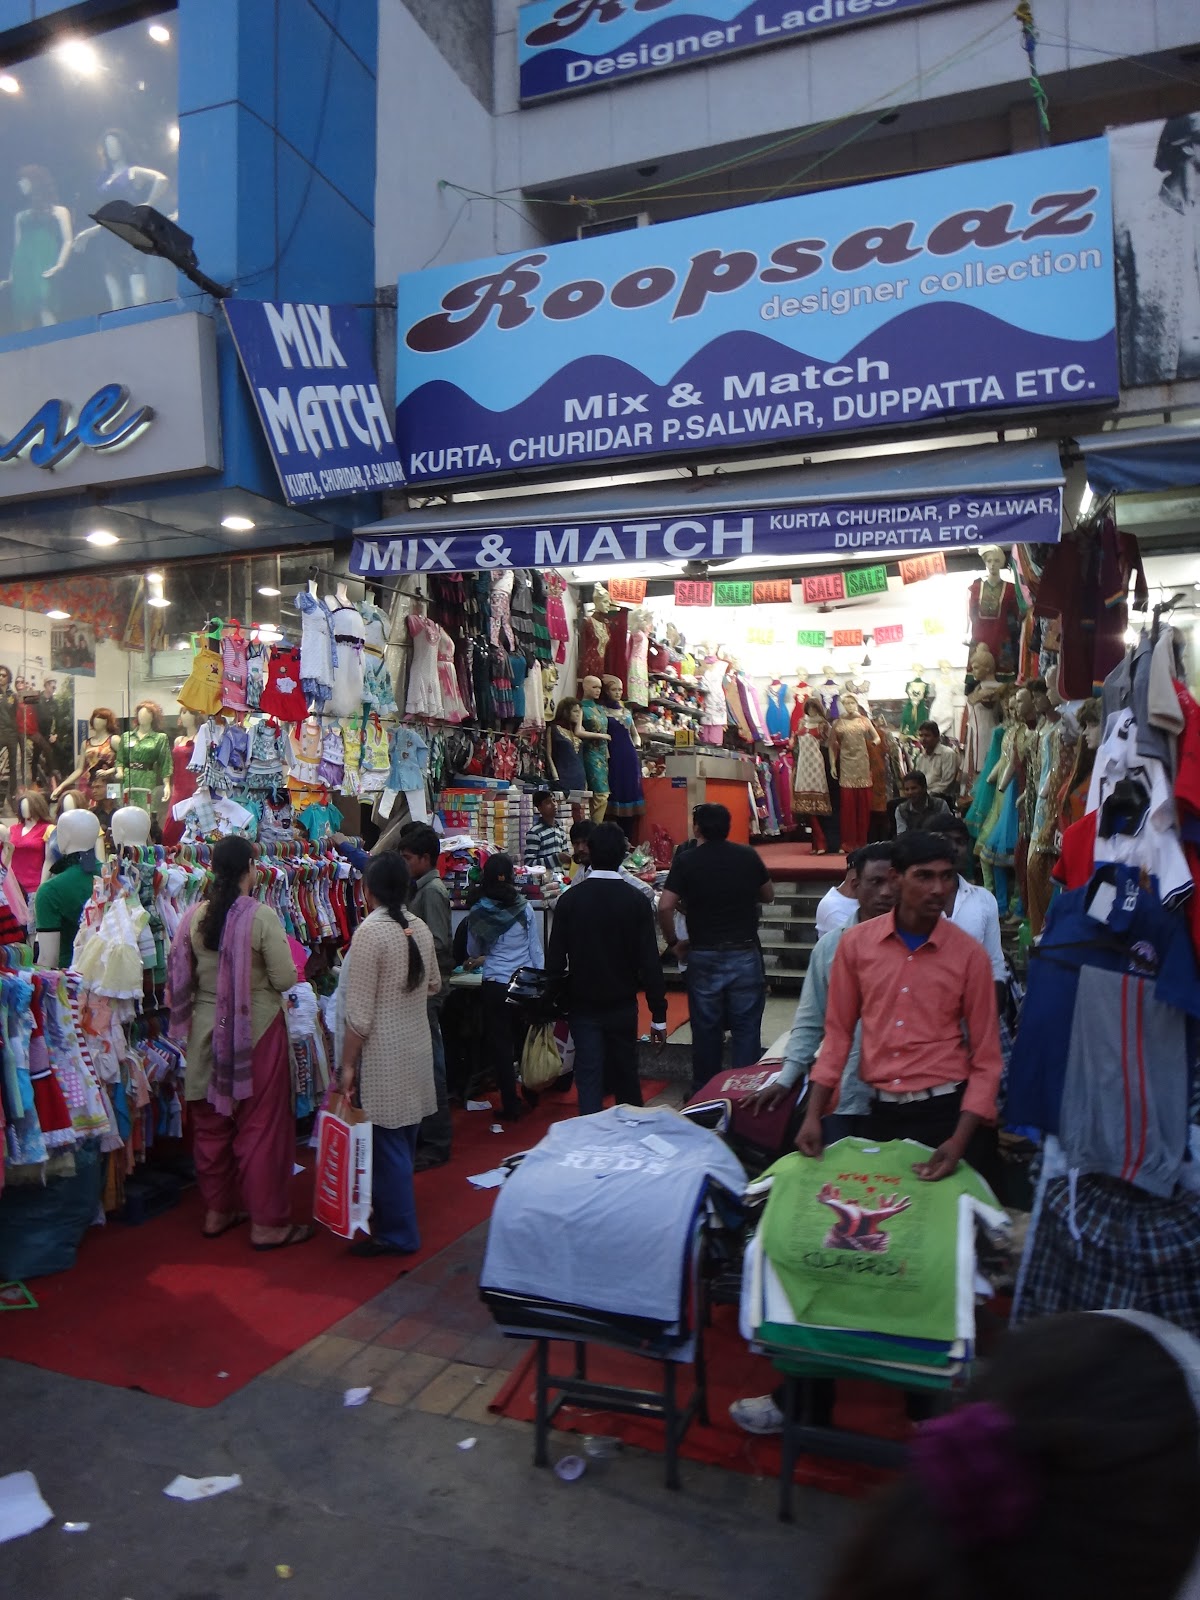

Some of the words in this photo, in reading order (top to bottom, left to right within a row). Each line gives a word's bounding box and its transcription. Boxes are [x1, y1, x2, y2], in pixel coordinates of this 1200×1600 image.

[566, 25, 742, 84] Designer
[405, 187, 1099, 353] Roopsaaz
[760, 277, 910, 321] designer
[919, 247, 1102, 297] collection
[262, 302, 348, 369] MIX
[564, 392, 649, 423] Mix
[667, 382, 704, 408] &
[723, 357, 890, 401] Match
[258, 384, 396, 460] MATCH
[410, 442, 502, 475] KURTA,
[508, 422, 653, 462] CHURIDAR
[662, 399, 824, 443] P.SALWAR,
[833, 375, 1004, 422] DUPPATTA
[1015, 364, 1096, 398] ETC.
[285, 472, 322, 497] KURTA,
[770, 511, 831, 530] KURTA
[836, 505, 943, 527] CHURIDAR,
[966, 497, 1059, 519] SALWAR,
[359, 536, 459, 571] MIX
[475, 533, 514, 567] &
[535, 517, 754, 564] MATCH
[834, 527, 933, 549] DUPPATTA
[938, 525, 984, 542] ETC.
[679, 582, 711, 604] SALE
[756, 582, 791, 601] SALE
[808, 575, 842, 600] SALE
[850, 568, 885, 593] SALE
[717, 583, 750, 604] SALE
[799, 631, 825, 646] SALE
[834, 631, 861, 646] SALE
[876, 626, 903, 644] SALE
[556, 1152, 670, 1176] REDS
